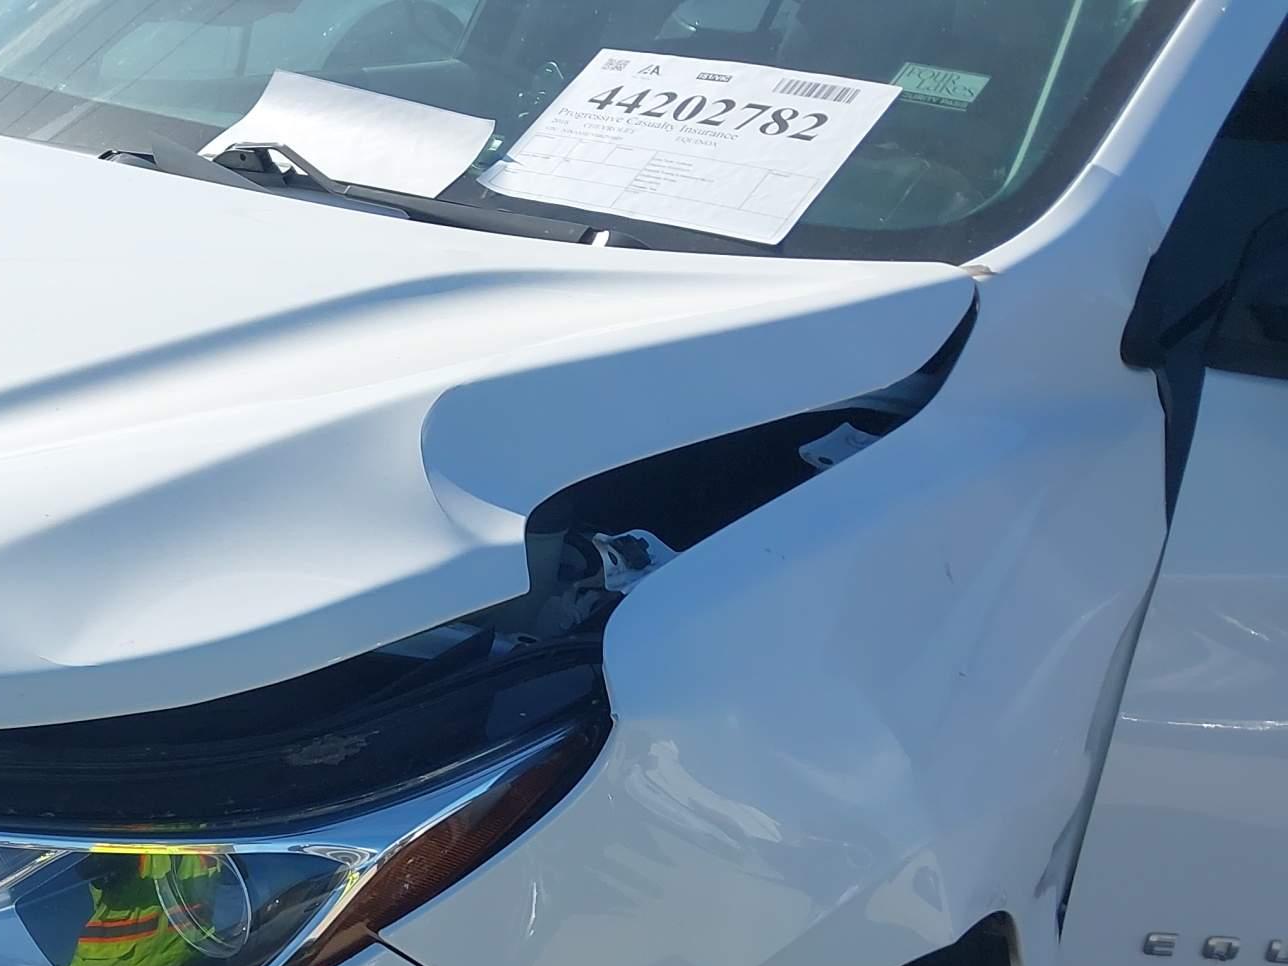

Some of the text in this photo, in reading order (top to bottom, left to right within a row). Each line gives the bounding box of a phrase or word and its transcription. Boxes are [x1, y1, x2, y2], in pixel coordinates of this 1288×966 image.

[558, 107, 739, 141] Progressive Casualty Insurance
[588, 85, 829, 141] 44202782
